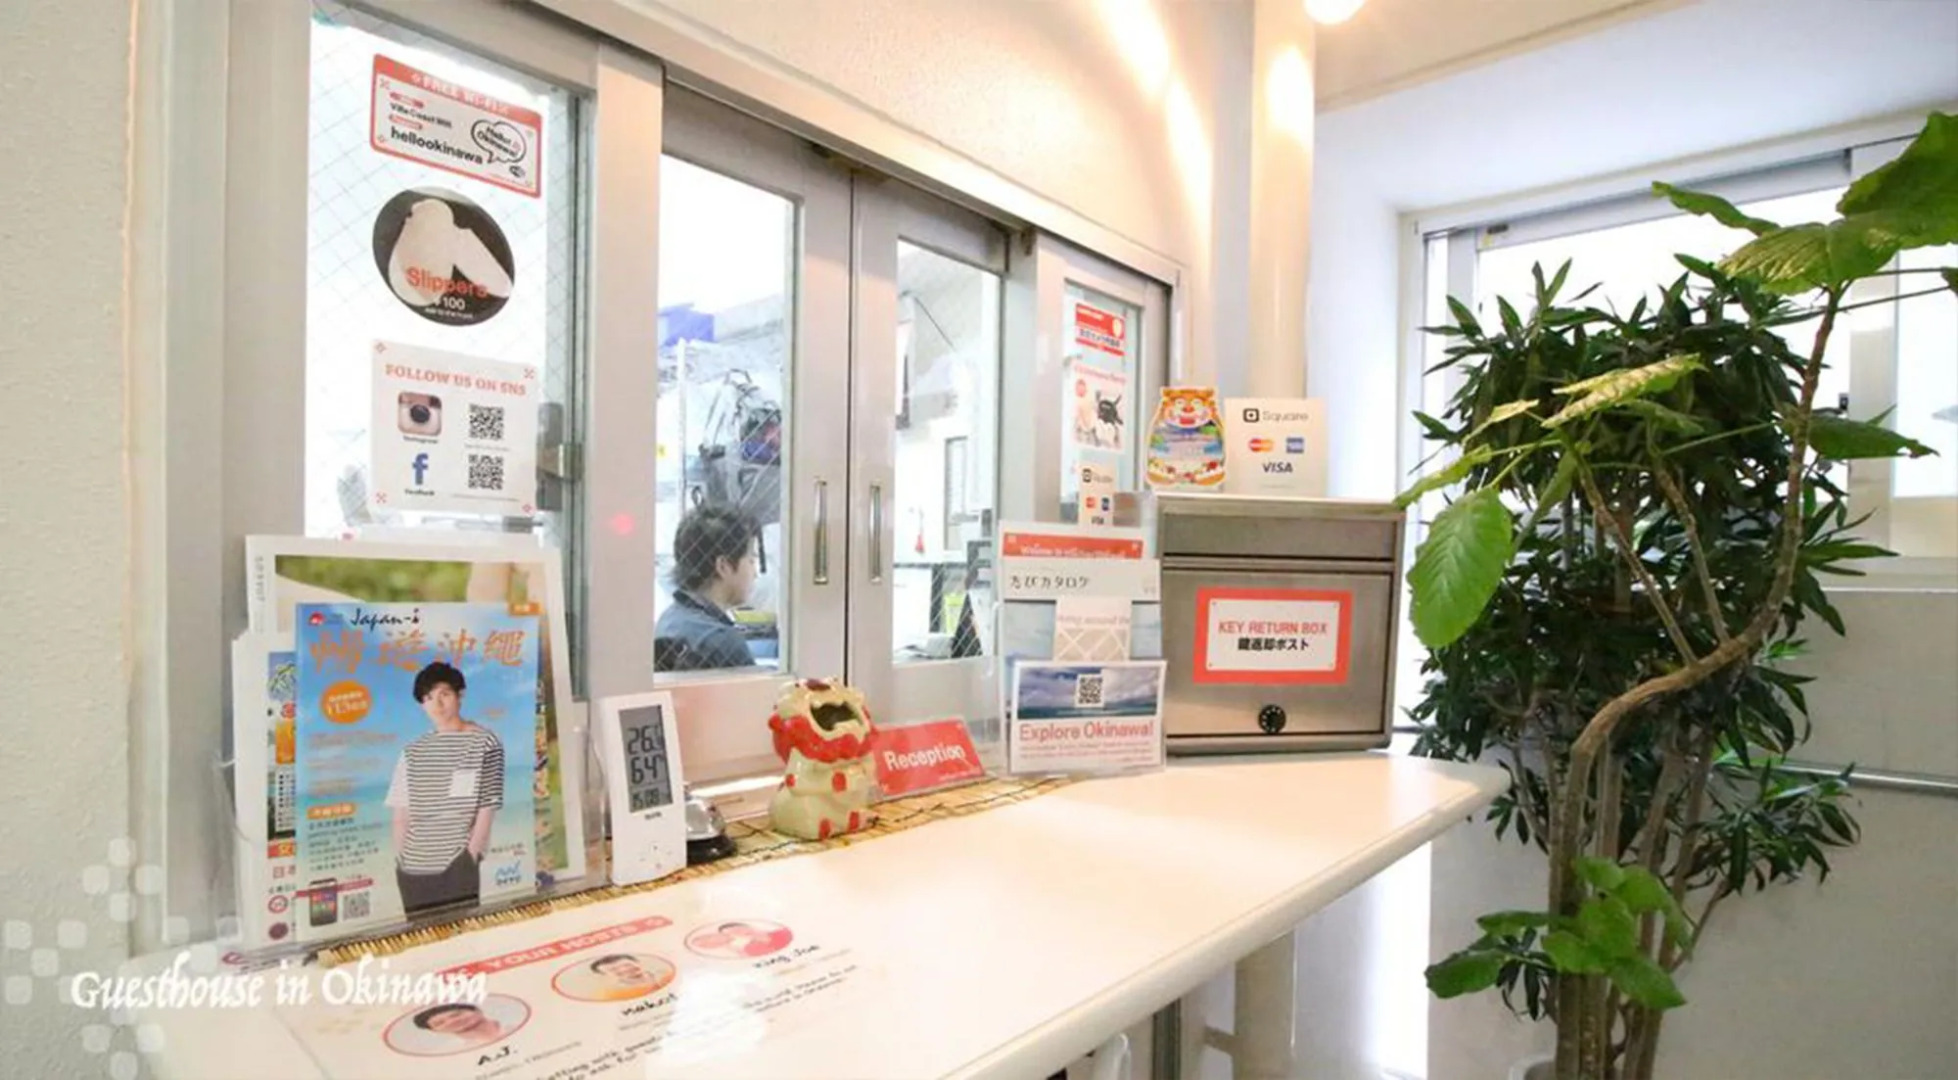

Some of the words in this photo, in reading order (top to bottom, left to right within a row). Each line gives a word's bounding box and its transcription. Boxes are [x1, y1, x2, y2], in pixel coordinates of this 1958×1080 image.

[391, 125, 483, 165] hellookinawa
[405, 266, 488, 298] Slippers
[385, 363, 451, 385] FOLLOW
[454, 374, 473, 389] US
[475, 379, 497, 392] ON
[499, 382, 526, 397] SNS
[1262, 461, 1293, 473] VISA
[351, 608, 420, 631] Japan-i
[1218, 621, 1246, 634] KEY
[1249, 621, 1299, 634] RETURN
[1301, 622, 1328, 634] BOX
[1019, 723, 1081, 743] Explore
[1084, 720, 1154, 740] Okinawa!
[883, 742, 967, 772] Reception
